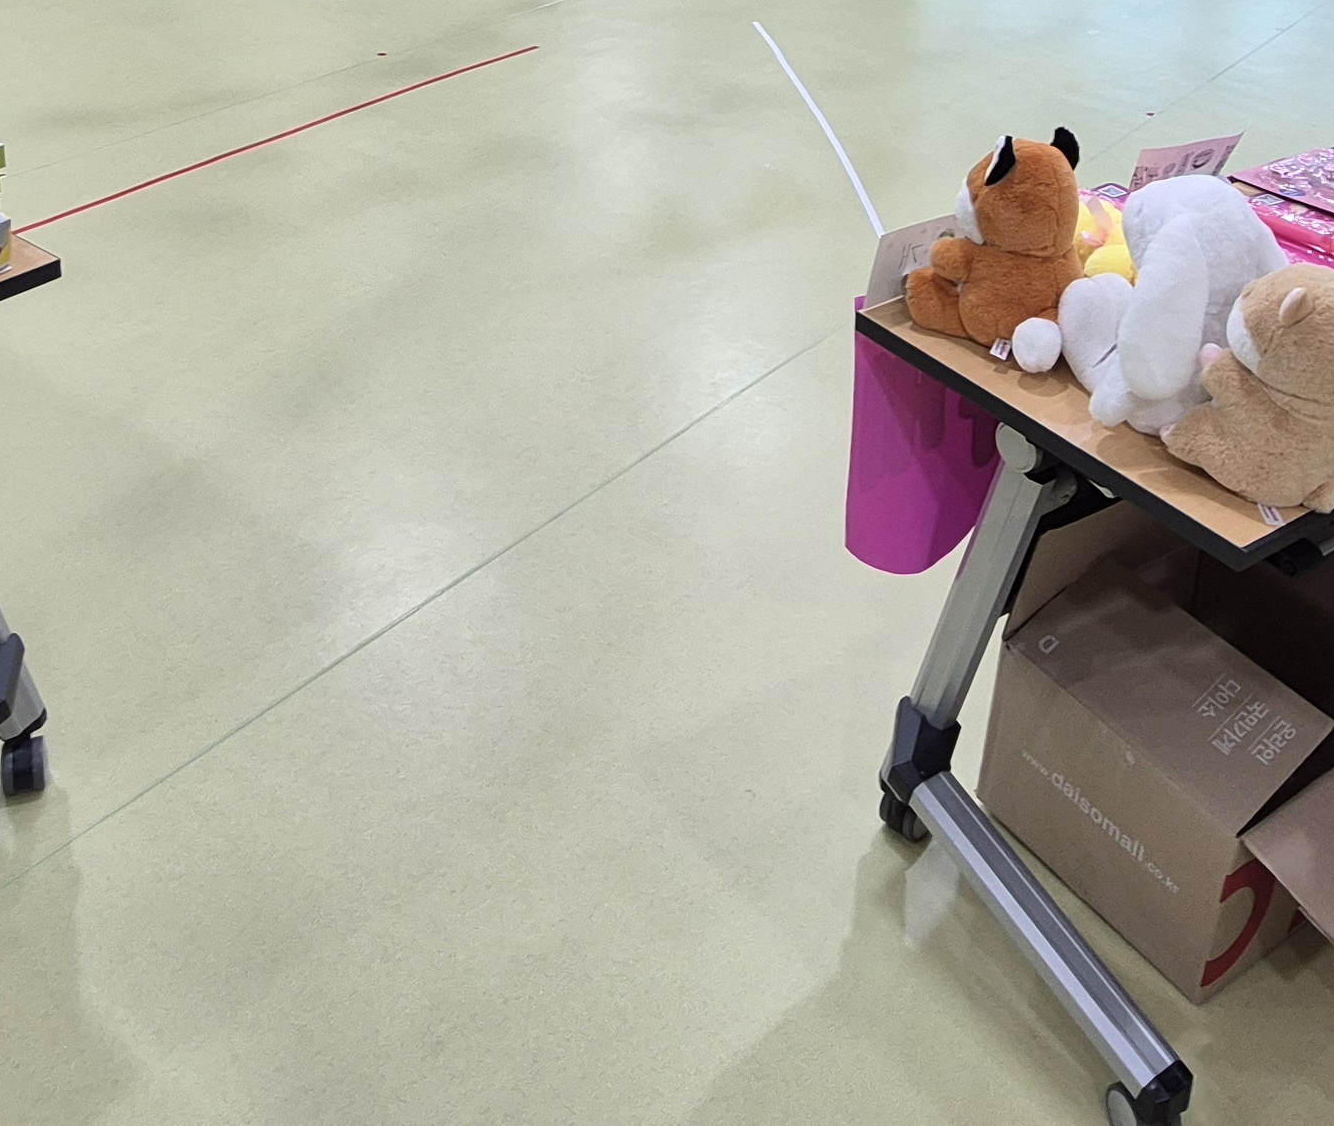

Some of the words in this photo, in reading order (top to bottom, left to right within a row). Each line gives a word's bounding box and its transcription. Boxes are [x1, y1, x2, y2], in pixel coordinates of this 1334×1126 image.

[1196, 679, 1242, 717] 다이소
[1211, 701, 1269, 756] 국민가게
[1250, 720, 1297, 766] 온라인
[1021, 749, 1181, 895] www.daisomall.co.kr
